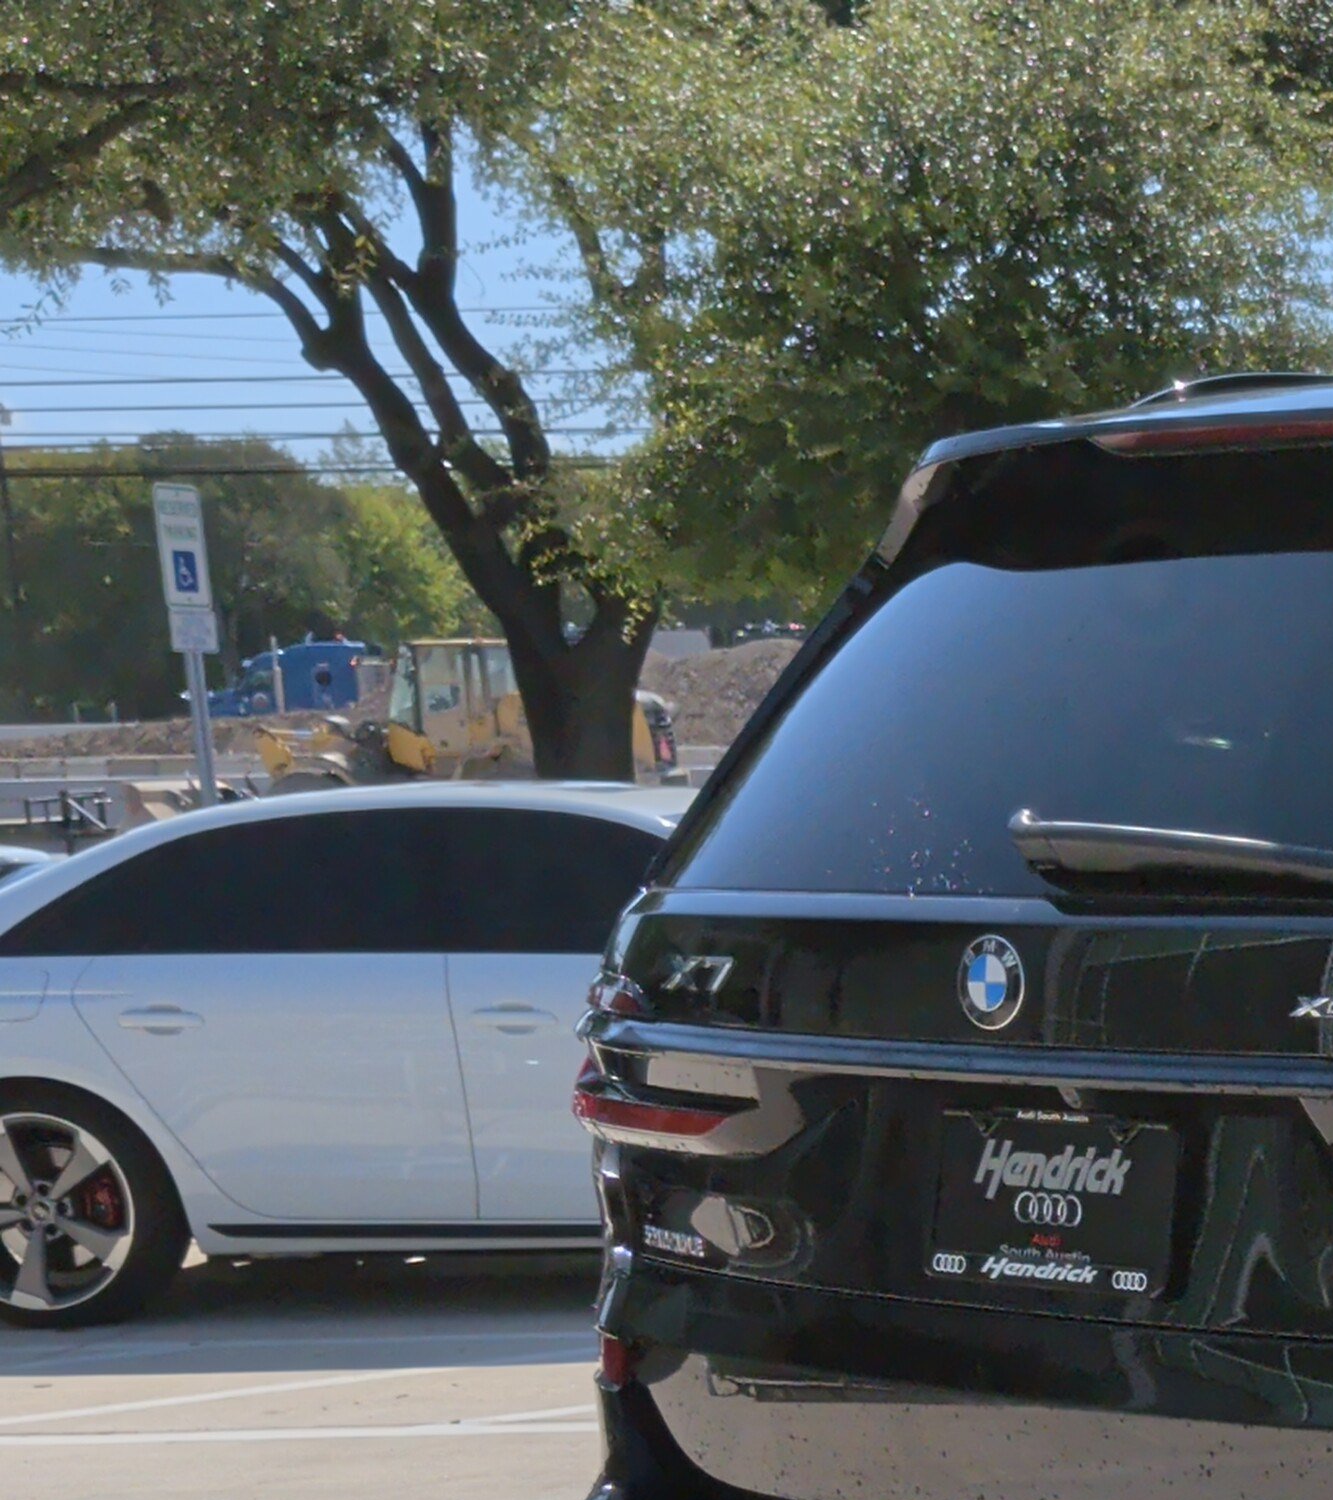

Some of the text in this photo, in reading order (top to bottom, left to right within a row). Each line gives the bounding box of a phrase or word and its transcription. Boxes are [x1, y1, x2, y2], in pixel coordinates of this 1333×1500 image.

[661, 954, 735, 993] X7
[1017, 1109, 1089, 1123] Audi South Austin
[974, 1138, 1132, 1200] Hendrick
[999, 1243, 1091, 1263] South Austin
[980, 1256, 1099, 1285] Hendrick
